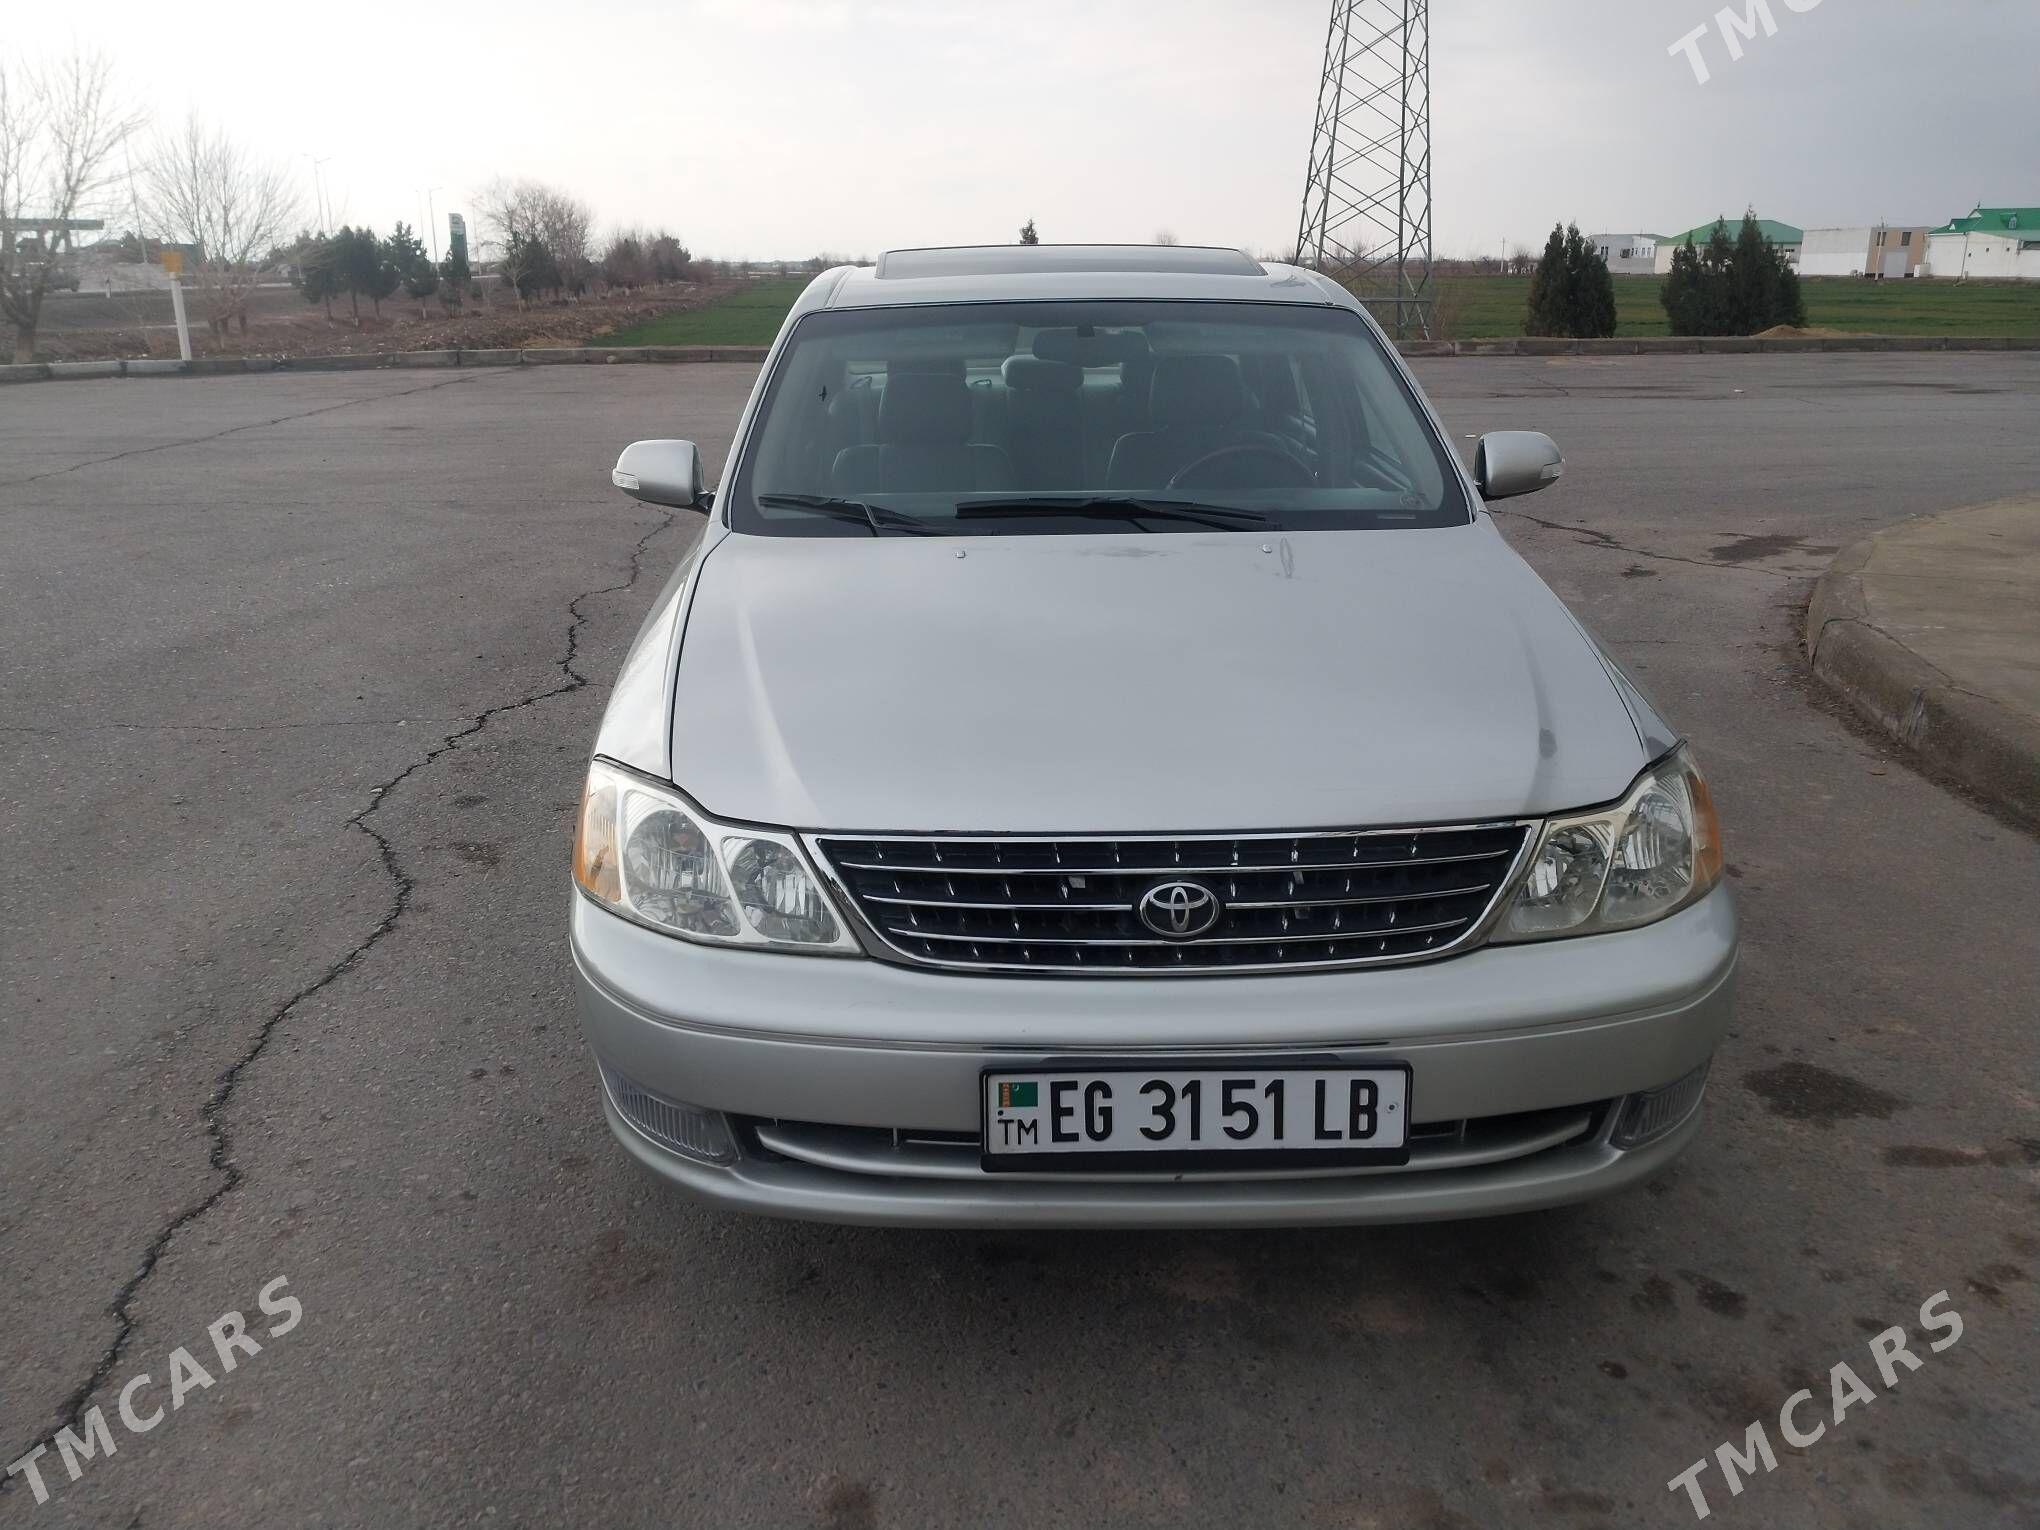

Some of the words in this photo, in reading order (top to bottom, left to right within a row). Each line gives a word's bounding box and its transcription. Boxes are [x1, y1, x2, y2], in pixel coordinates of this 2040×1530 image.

[998, 1119, 1038, 1145] TM
[1050, 1080, 1113, 1142] EG
[1314, 1079, 1378, 1140] LB
